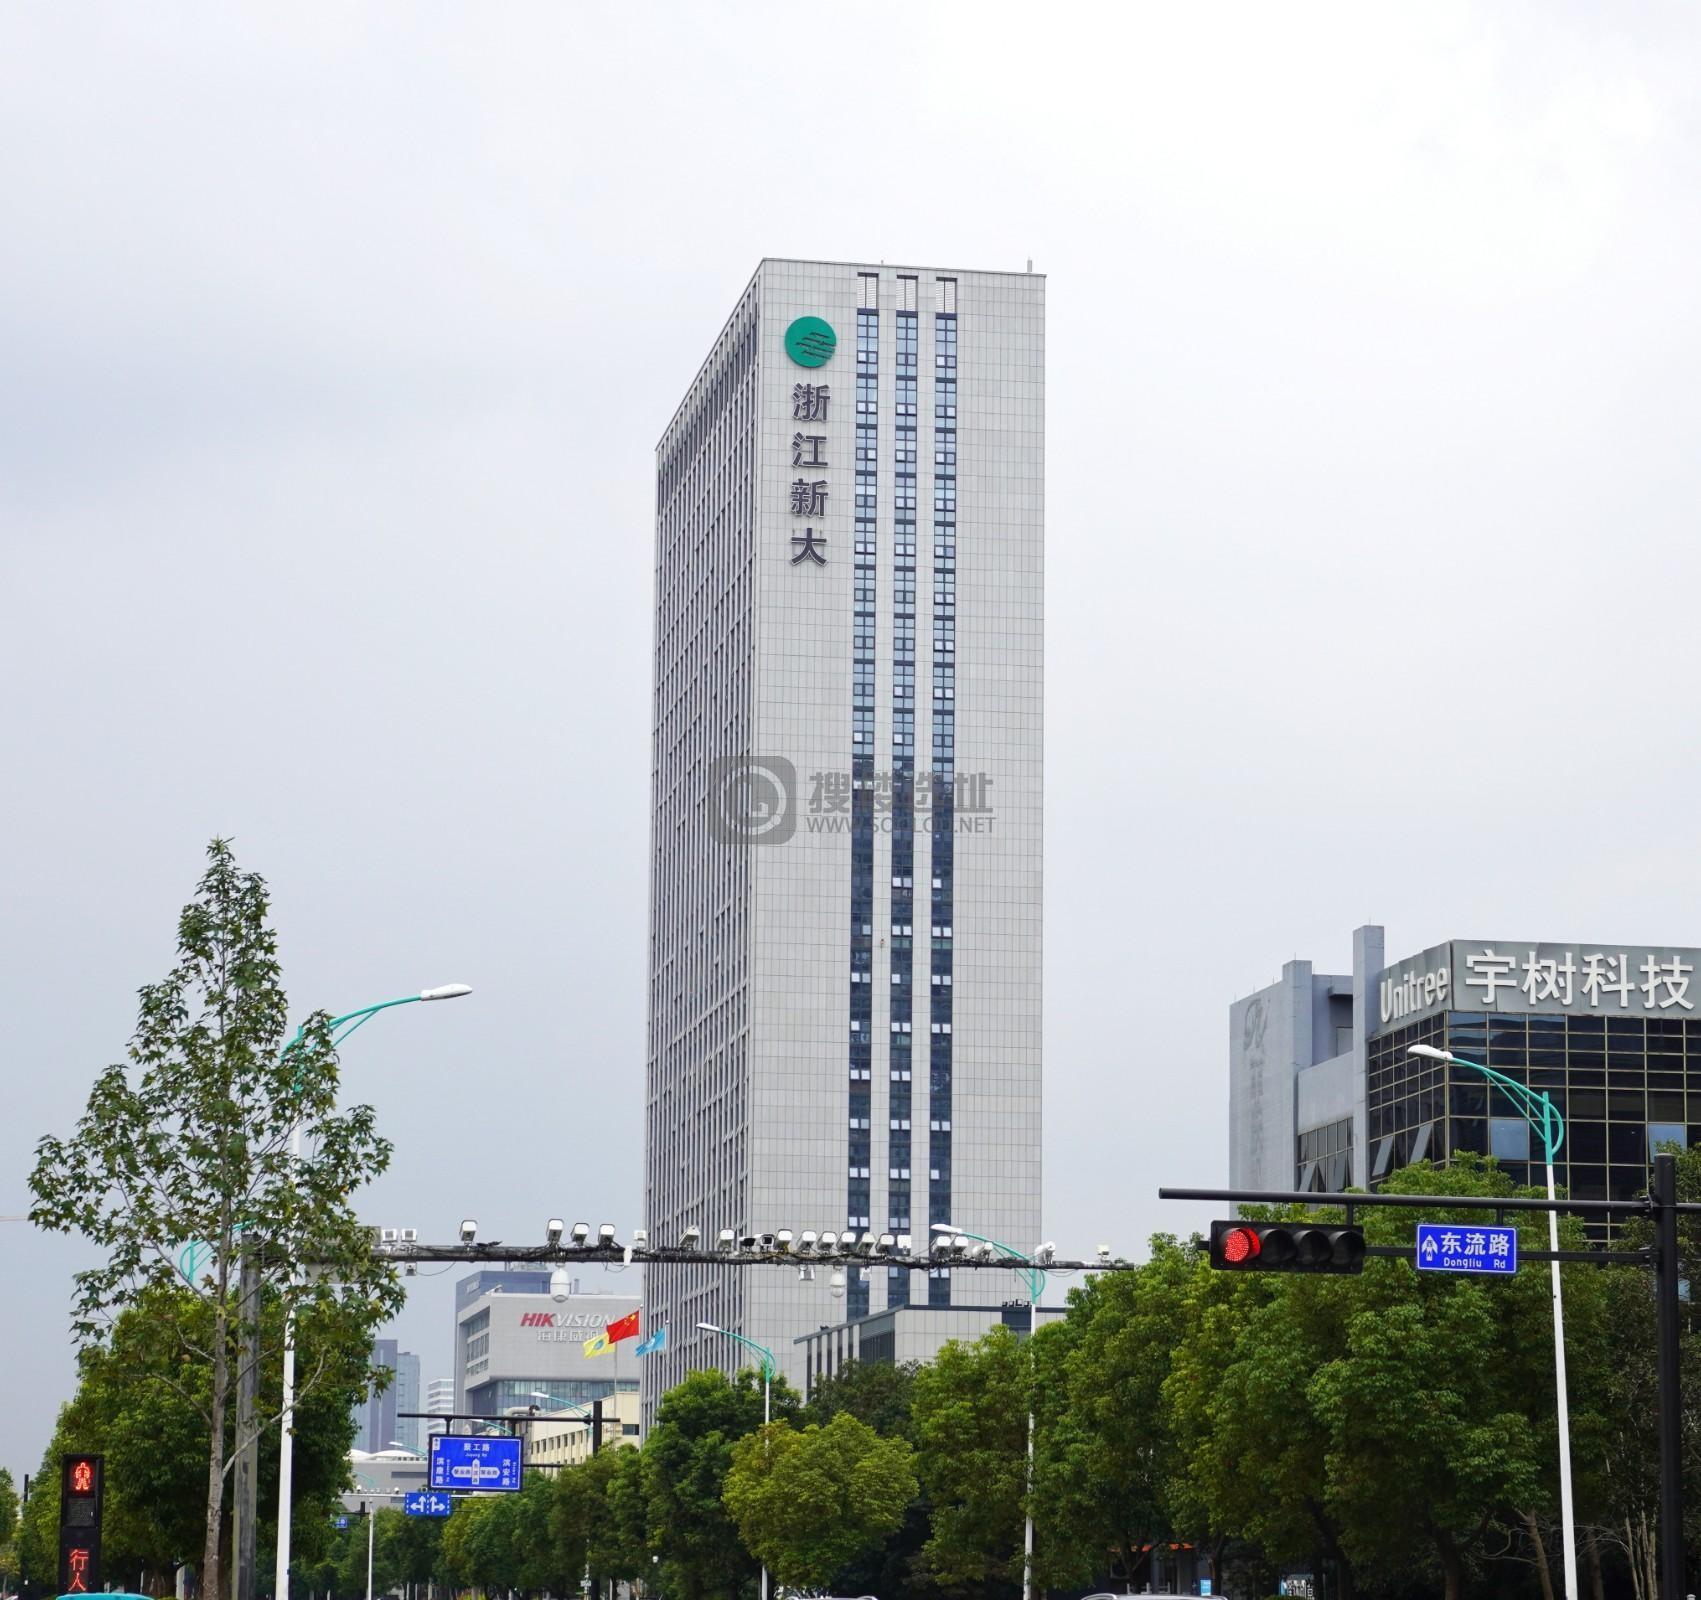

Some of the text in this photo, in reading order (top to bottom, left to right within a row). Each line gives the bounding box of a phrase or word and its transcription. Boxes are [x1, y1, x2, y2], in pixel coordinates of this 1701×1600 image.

[791, 383, 830, 566] 浙江新大
[1380, 968, 1448, 1023] Unitree
[1466, 950, 1694, 1009] 宇树科技
[1441, 1232, 1509, 1256] 东流路
[1443, 1257, 1505, 1269] Dongliu Rd
[520, 1312, 615, 1328] HIKVISION
[69, 1549, 88, 1591] 行人
